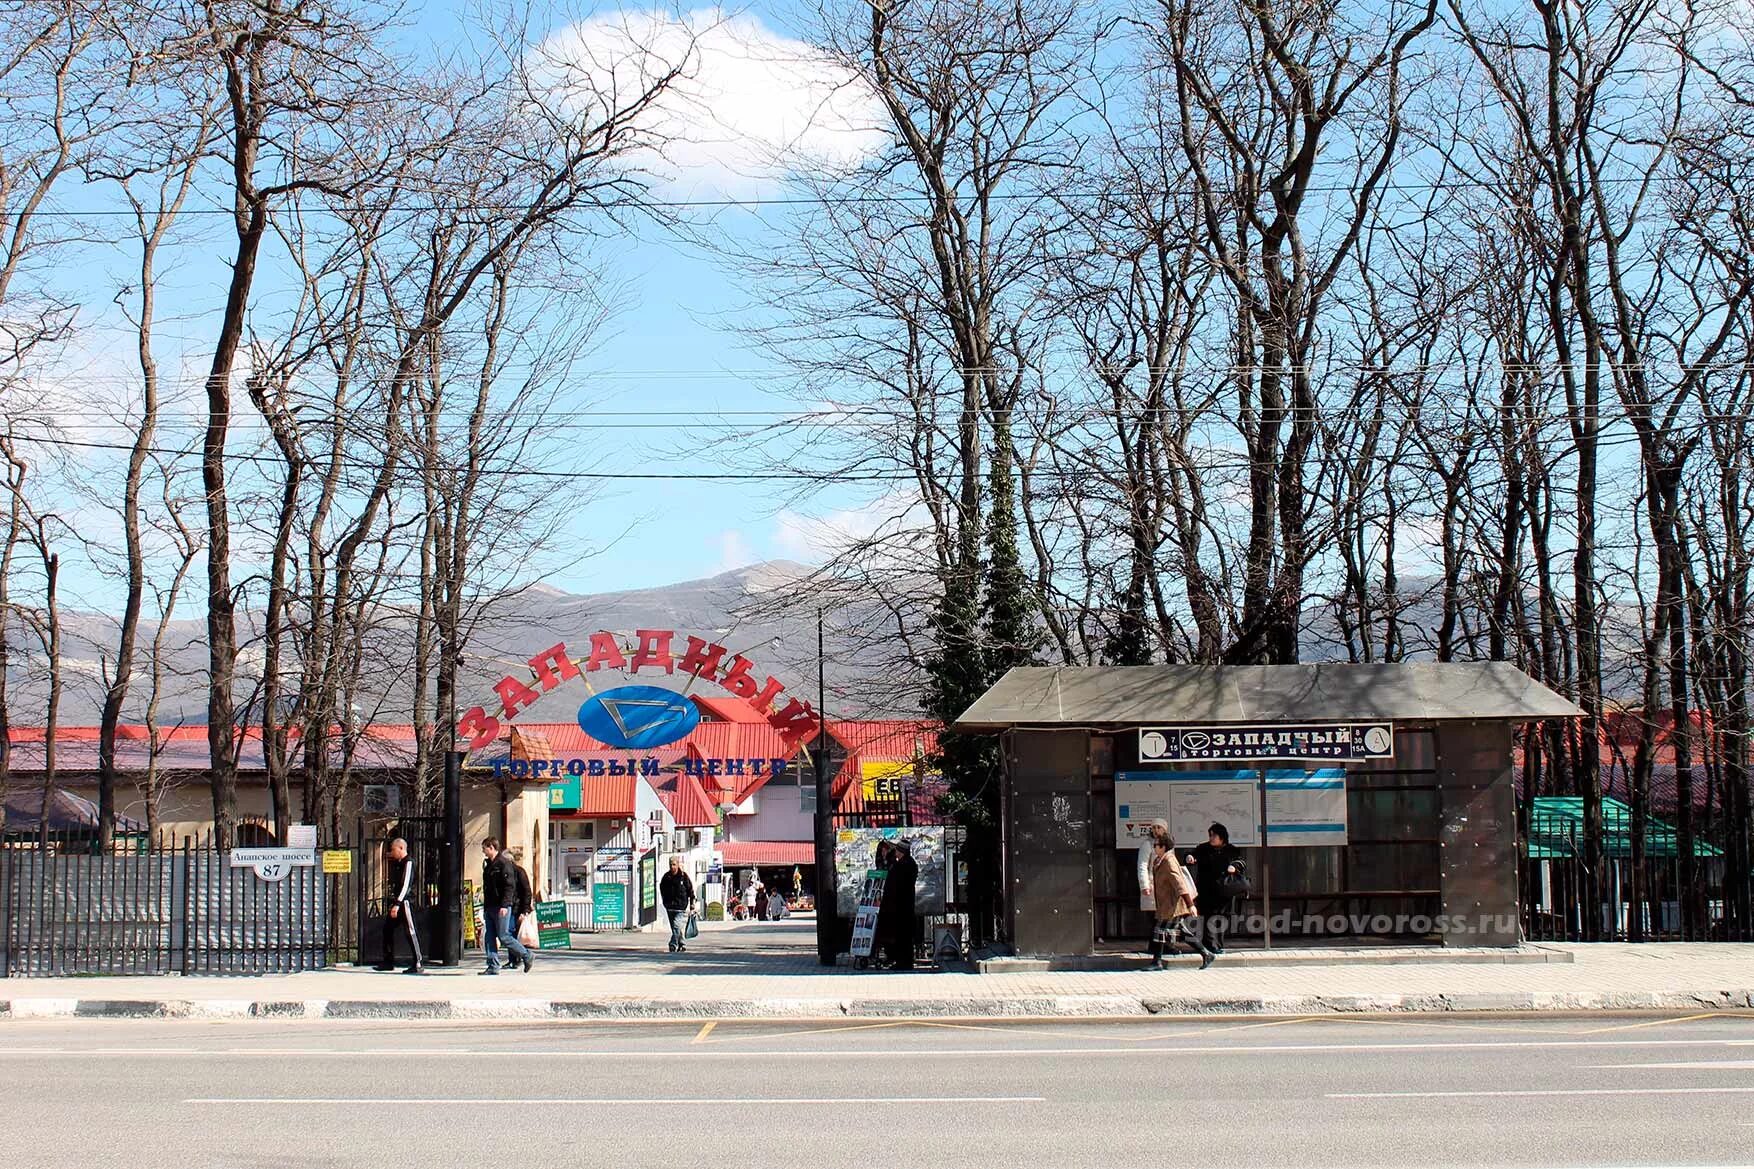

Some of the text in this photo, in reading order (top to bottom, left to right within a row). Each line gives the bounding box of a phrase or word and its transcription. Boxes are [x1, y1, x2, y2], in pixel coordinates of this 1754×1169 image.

[459, 630, 820, 750] ЗАПАДНЫЙ
[1288, 746, 1342, 756] центр
[490, 756, 788, 779] ТОРГОВЫЙ ЦЕНТР
[234, 852, 311, 861] Анапское шоссе
[263, 864, 281, 877] 87
